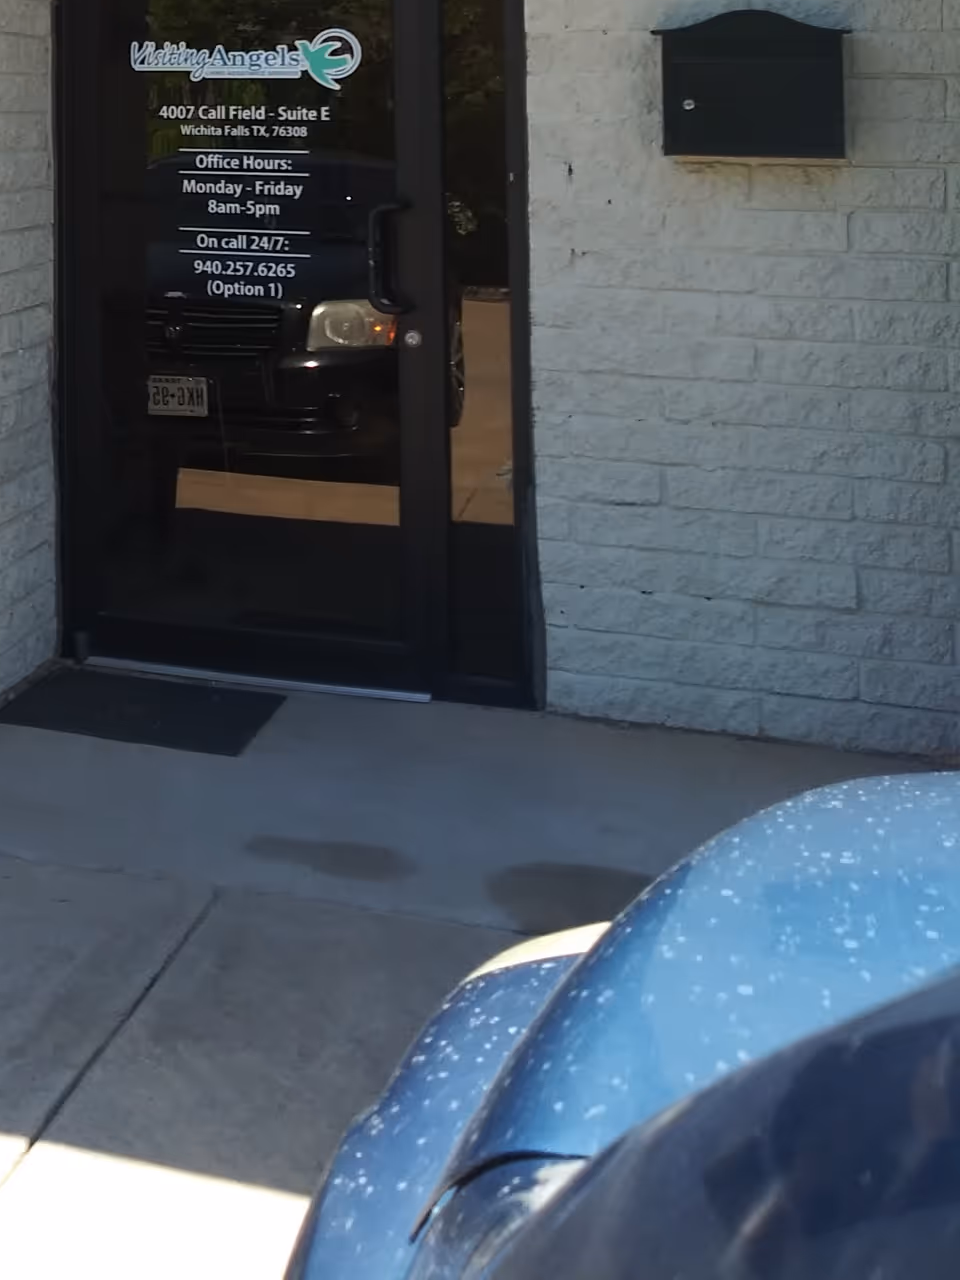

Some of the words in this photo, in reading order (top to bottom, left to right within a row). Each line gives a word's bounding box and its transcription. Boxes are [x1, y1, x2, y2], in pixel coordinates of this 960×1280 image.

[132, 41, 210, 80] Visiting
[210, 46, 300, 70] Angels
[159, 106, 195, 119] 4007
[198, 106, 225, 119] Call
[229, 106, 265, 119] Field
[278, 106, 317, 120] Suite
[321, 107, 330, 120] E
[180, 125, 222, 135] Wichita
[225, 125, 250, 136] Falls
[252, 126, 269, 137] TX,
[272, 126, 307, 137] 76308
[196, 154, 239, 169] Office
[243, 156, 292, 170] Hours:
[183, 180, 243, 197] Monday
[255, 181, 303, 199] Friday
[208, 200, 280, 217] 8am-5pm
[197, 234, 218, 248] On
[221, 235, 246, 249] call
[250, 236, 289, 251] 24/7:
[194, 260, 295, 277] 940.257.6265
[208, 280, 264, 298] (Option
[268, 283, 282, 298] 1)
